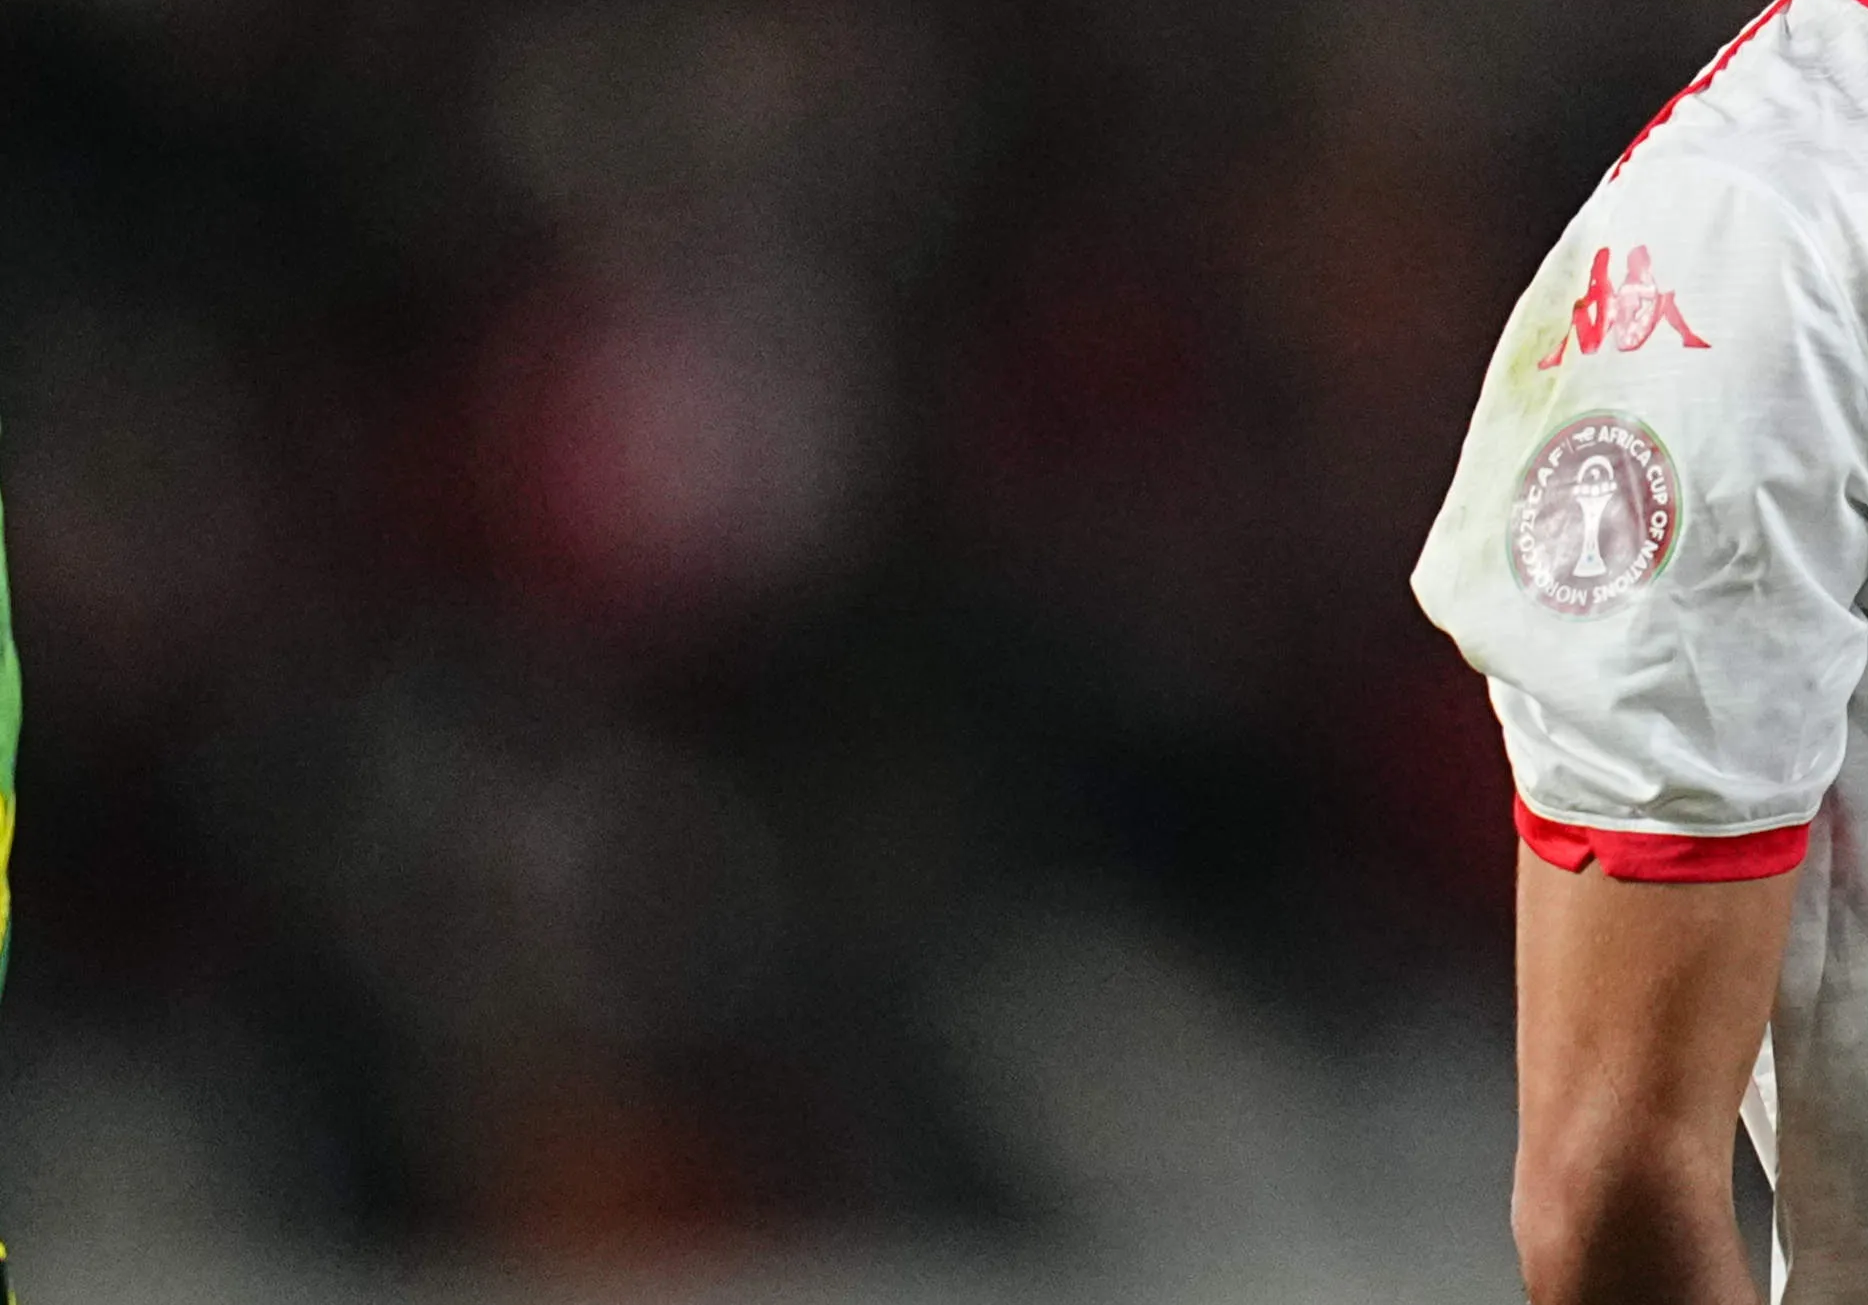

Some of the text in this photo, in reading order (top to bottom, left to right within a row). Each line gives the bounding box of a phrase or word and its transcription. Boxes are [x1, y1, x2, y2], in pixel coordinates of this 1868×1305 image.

[1598, 425, 1652, 467] AFRICA
[1646, 465, 1668, 505] CUP
[1649, 510, 1668, 541] OF
[1592, 539, 1659, 604] NATIONS
